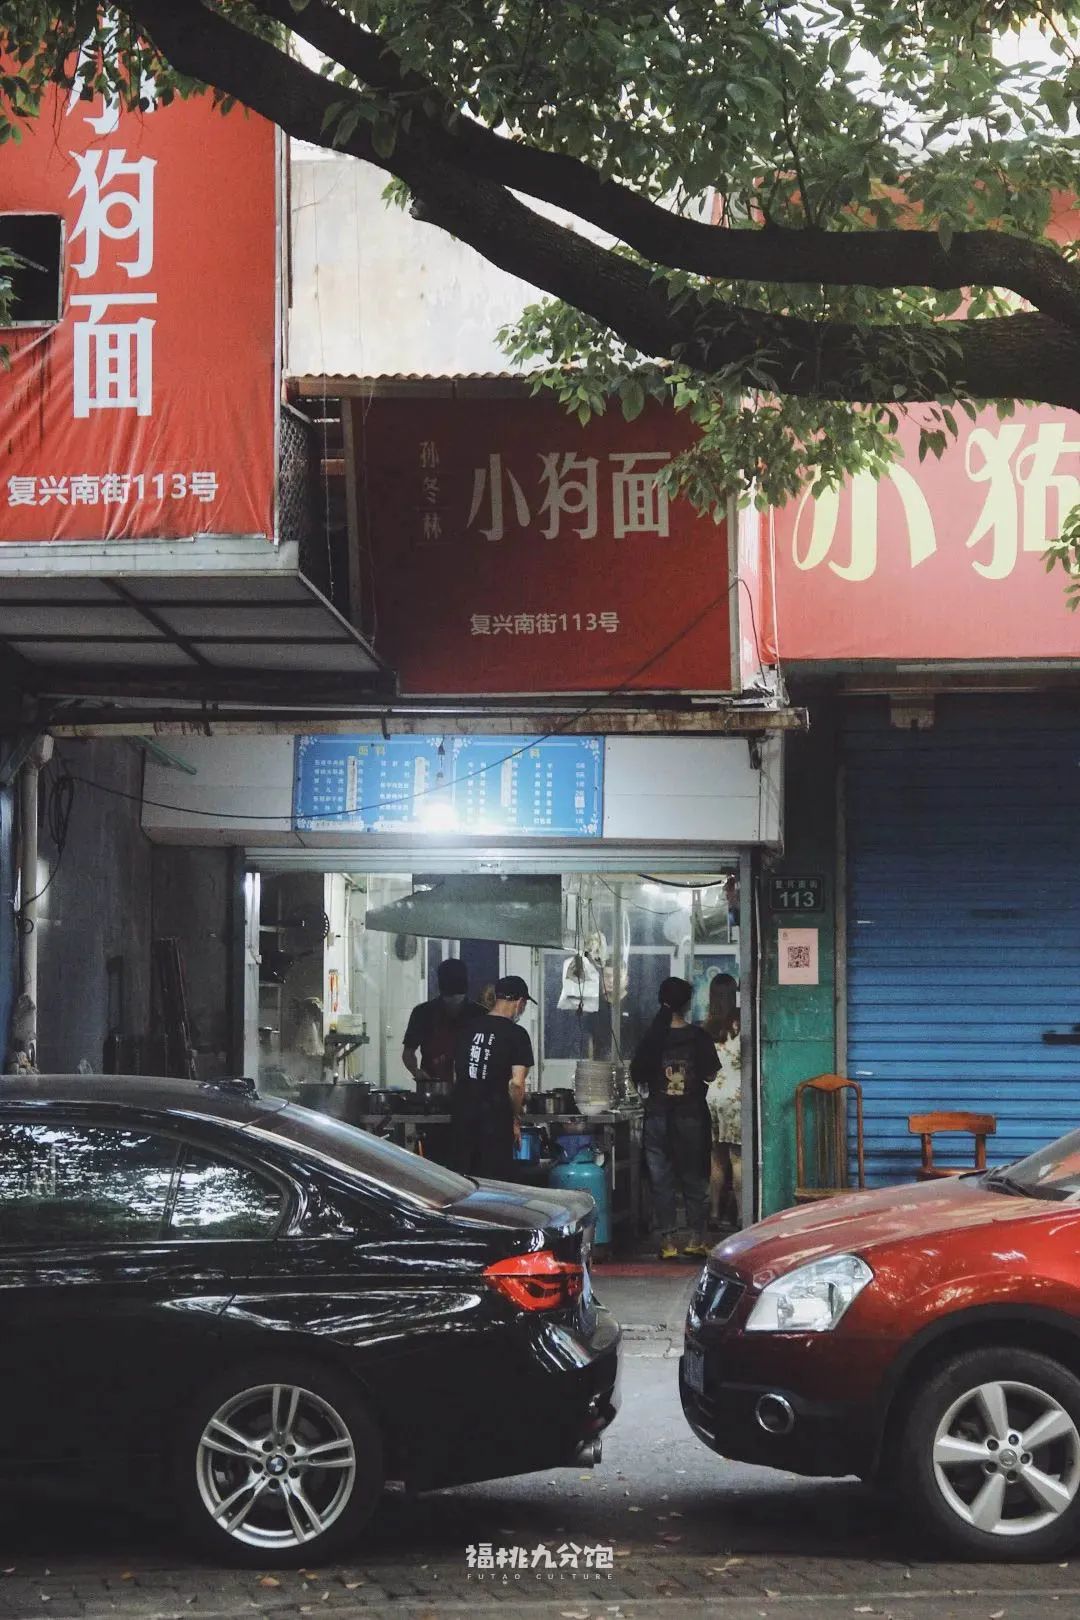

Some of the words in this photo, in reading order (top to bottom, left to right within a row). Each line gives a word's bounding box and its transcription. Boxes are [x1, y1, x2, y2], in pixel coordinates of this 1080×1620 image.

[7, 472, 219, 507] 复兴南街113号
[419, 441, 442, 540] 孙冬林
[466, 452, 671, 541] 小狗面
[470, 611, 620, 635] 复兴南街113号
[780, 892, 815, 907] 113
[468, 1032, 485, 1079] 小狗面
